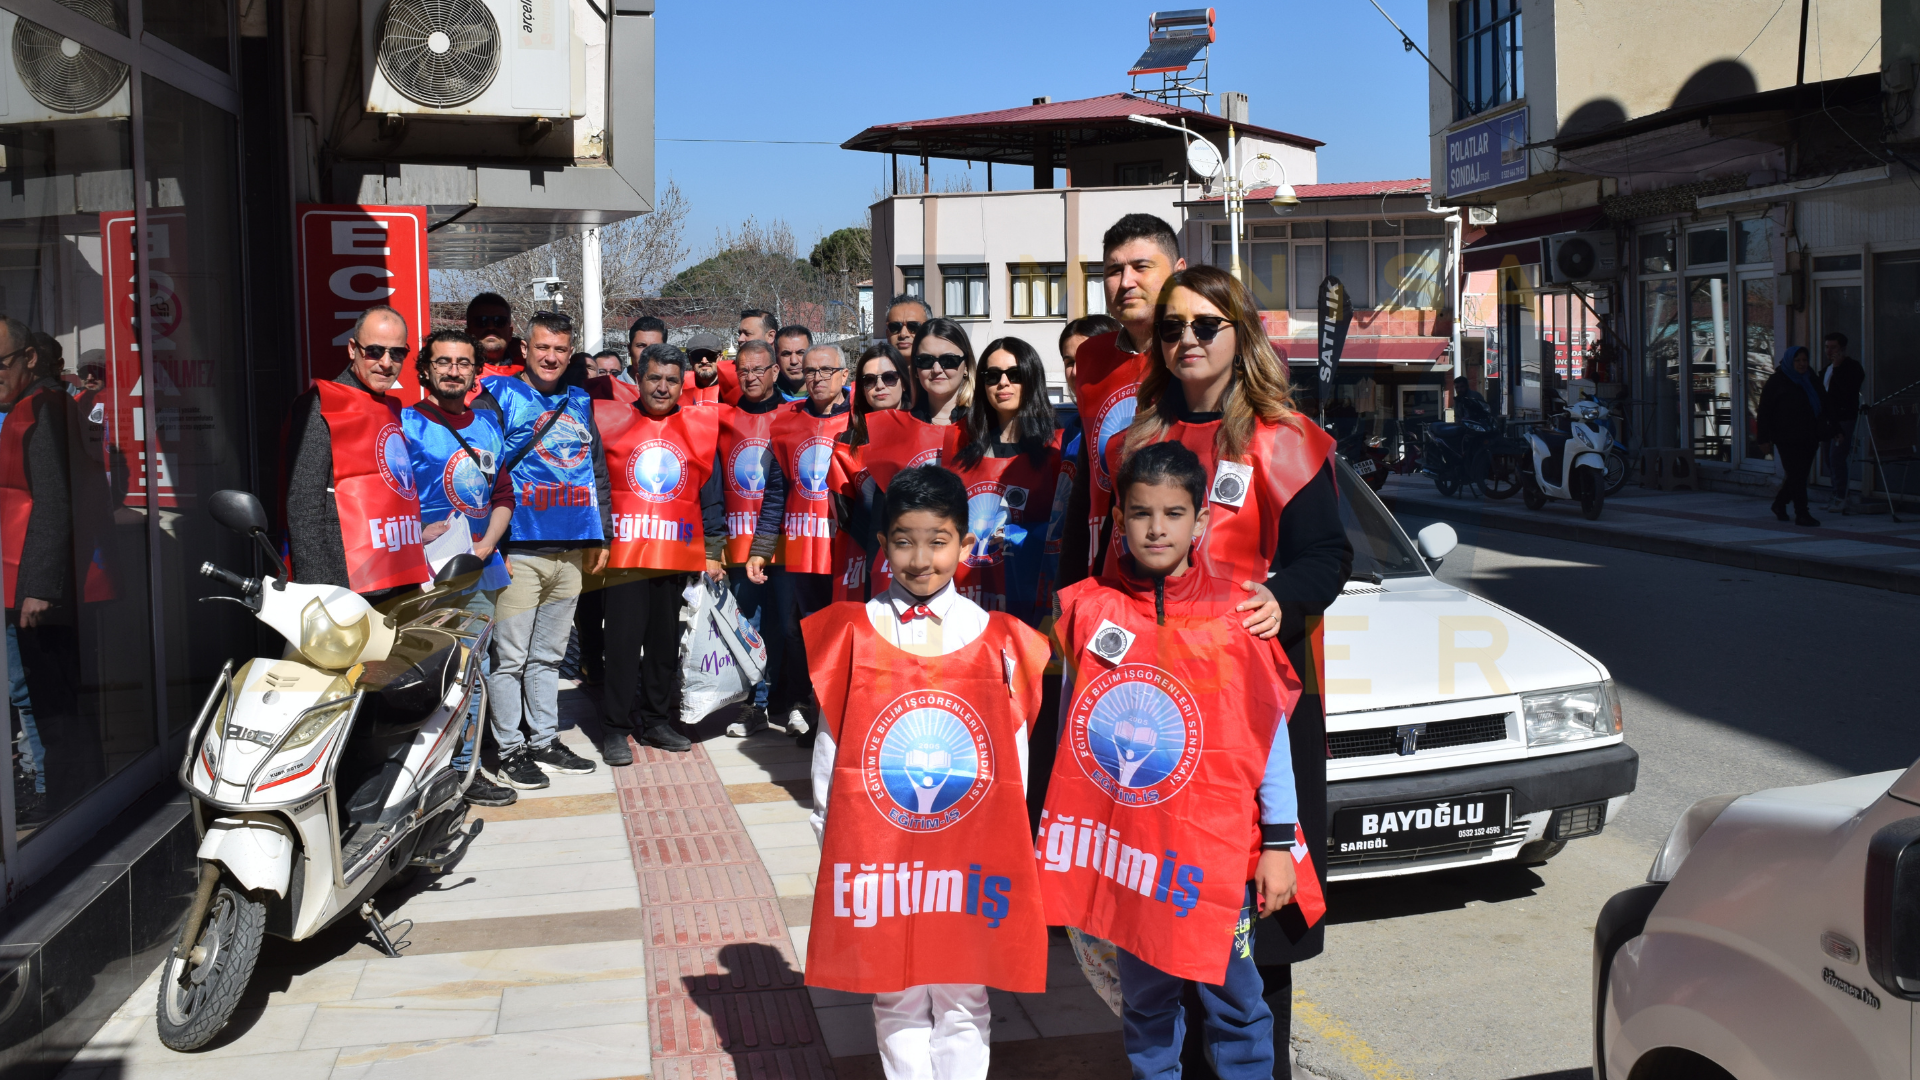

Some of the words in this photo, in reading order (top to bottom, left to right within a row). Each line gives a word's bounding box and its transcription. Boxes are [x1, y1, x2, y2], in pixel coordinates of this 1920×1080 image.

[522, 0, 535, 33] arçel
[1450, 132, 1489, 163] POLATLAR
[1451, 162, 1480, 189] SONDAJ
[1319, 280, 1339, 383] SATILIK
[611, 513, 694, 547] Eğitimiş
[1092, 673, 1122, 697] BİLİM
[1124, 669, 1194, 717] İŞGÖRENLERİ
[876, 704, 904, 734] BİLİM
[904, 694, 981, 732] İŞGÖRENLERİ
[1081, 697, 1094, 712] VE
[1128, 715, 1149, 726] 2005
[870, 736, 881, 752] VE
[1074, 714, 1089, 758] EĞİTİM
[968, 734, 989, 801] SENDİKASI
[1170, 720, 1198, 786] SENDİKASI
[866, 755, 885, 800] EĞİTİM
[1092, 769, 1160, 803] EĞİTİM-İŞ
[888, 807, 961, 830] EĞİTİM-İŞ
[1362, 802, 1484, 836] BAYOĞLU
[1458, 829, 1474, 838] 0532
[1486, 825, 1501, 835] 4595
[1340, 837, 1388, 853] SARIGÖL
[1034, 808, 1204, 918] Eğitimiş
[833, 860, 1012, 929] Eğitimiş
[1861, 987, 1881, 1010] Oto
